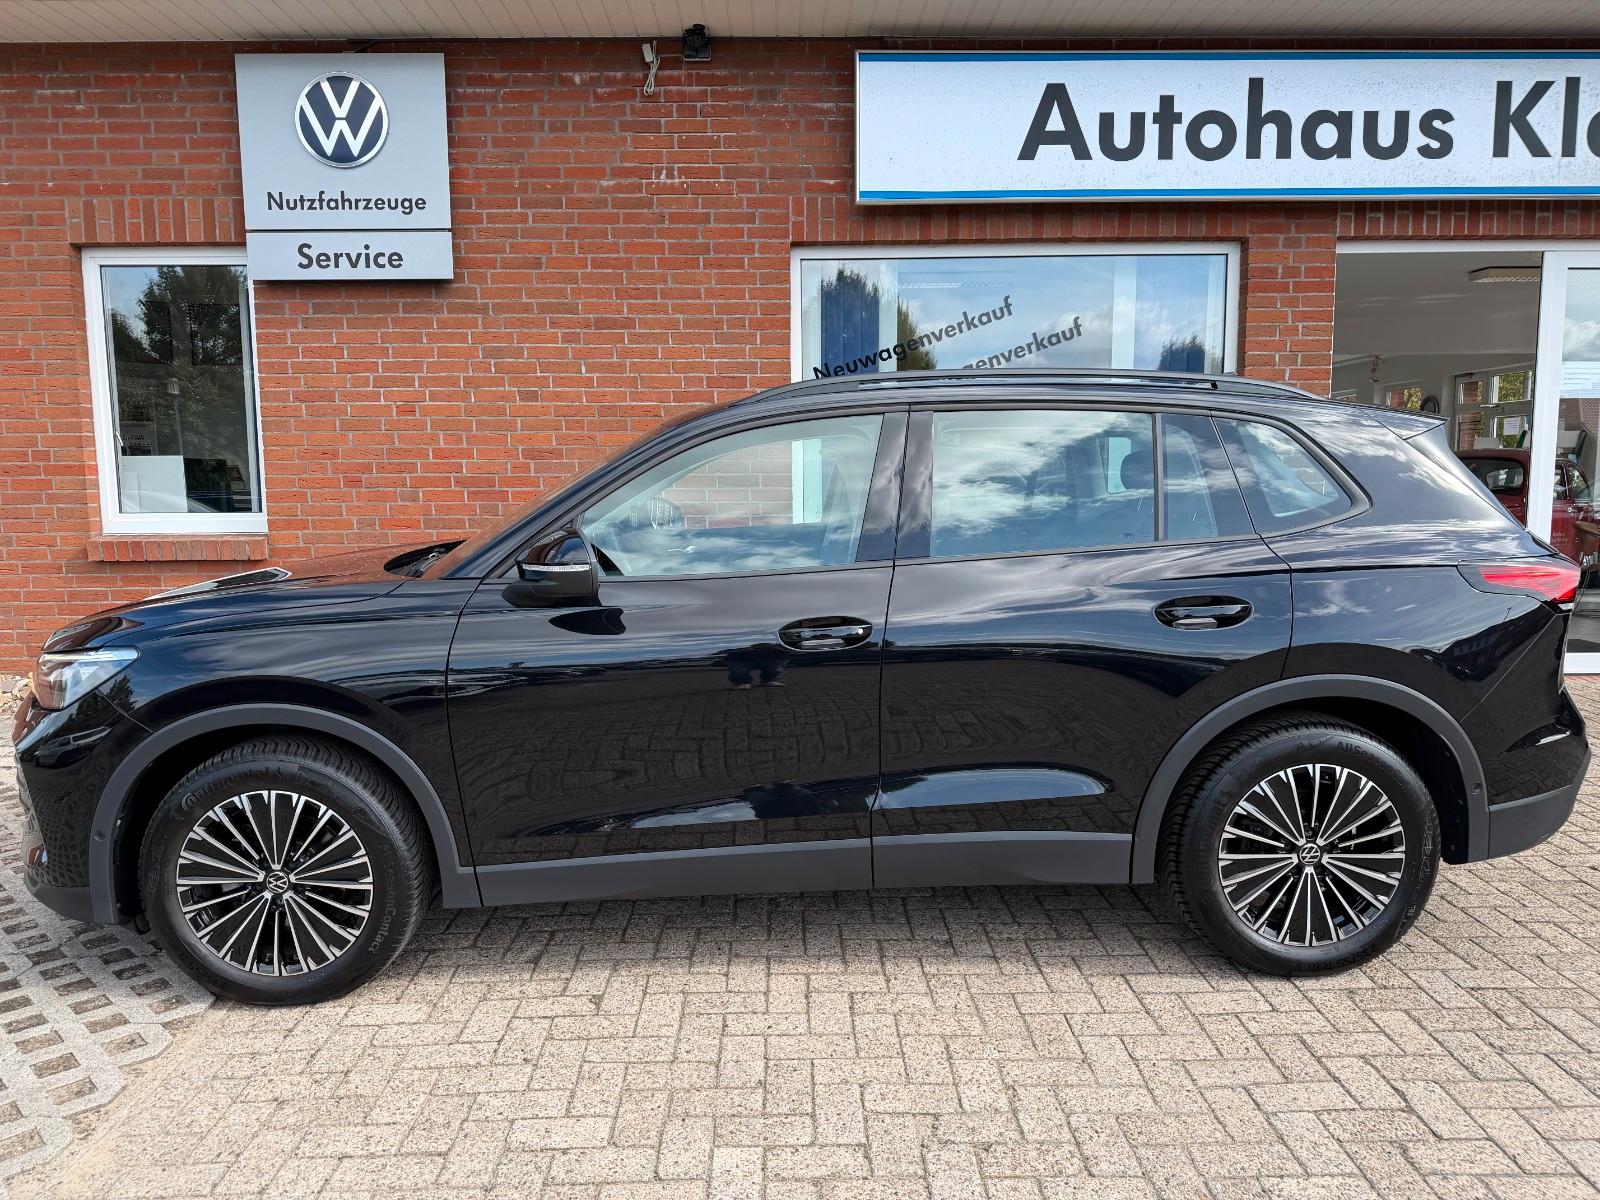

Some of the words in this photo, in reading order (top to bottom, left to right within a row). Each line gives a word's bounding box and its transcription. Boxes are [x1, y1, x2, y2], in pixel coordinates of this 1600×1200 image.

[1016, 76, 1455, 162] Autohaus
[1491, 76, 1600, 159] Kl
[266, 190, 427, 216] Nutzfahrzeuge
[297, 242, 404, 270] Service
[812, 294, 1014, 379] Neuwagenverkauf
